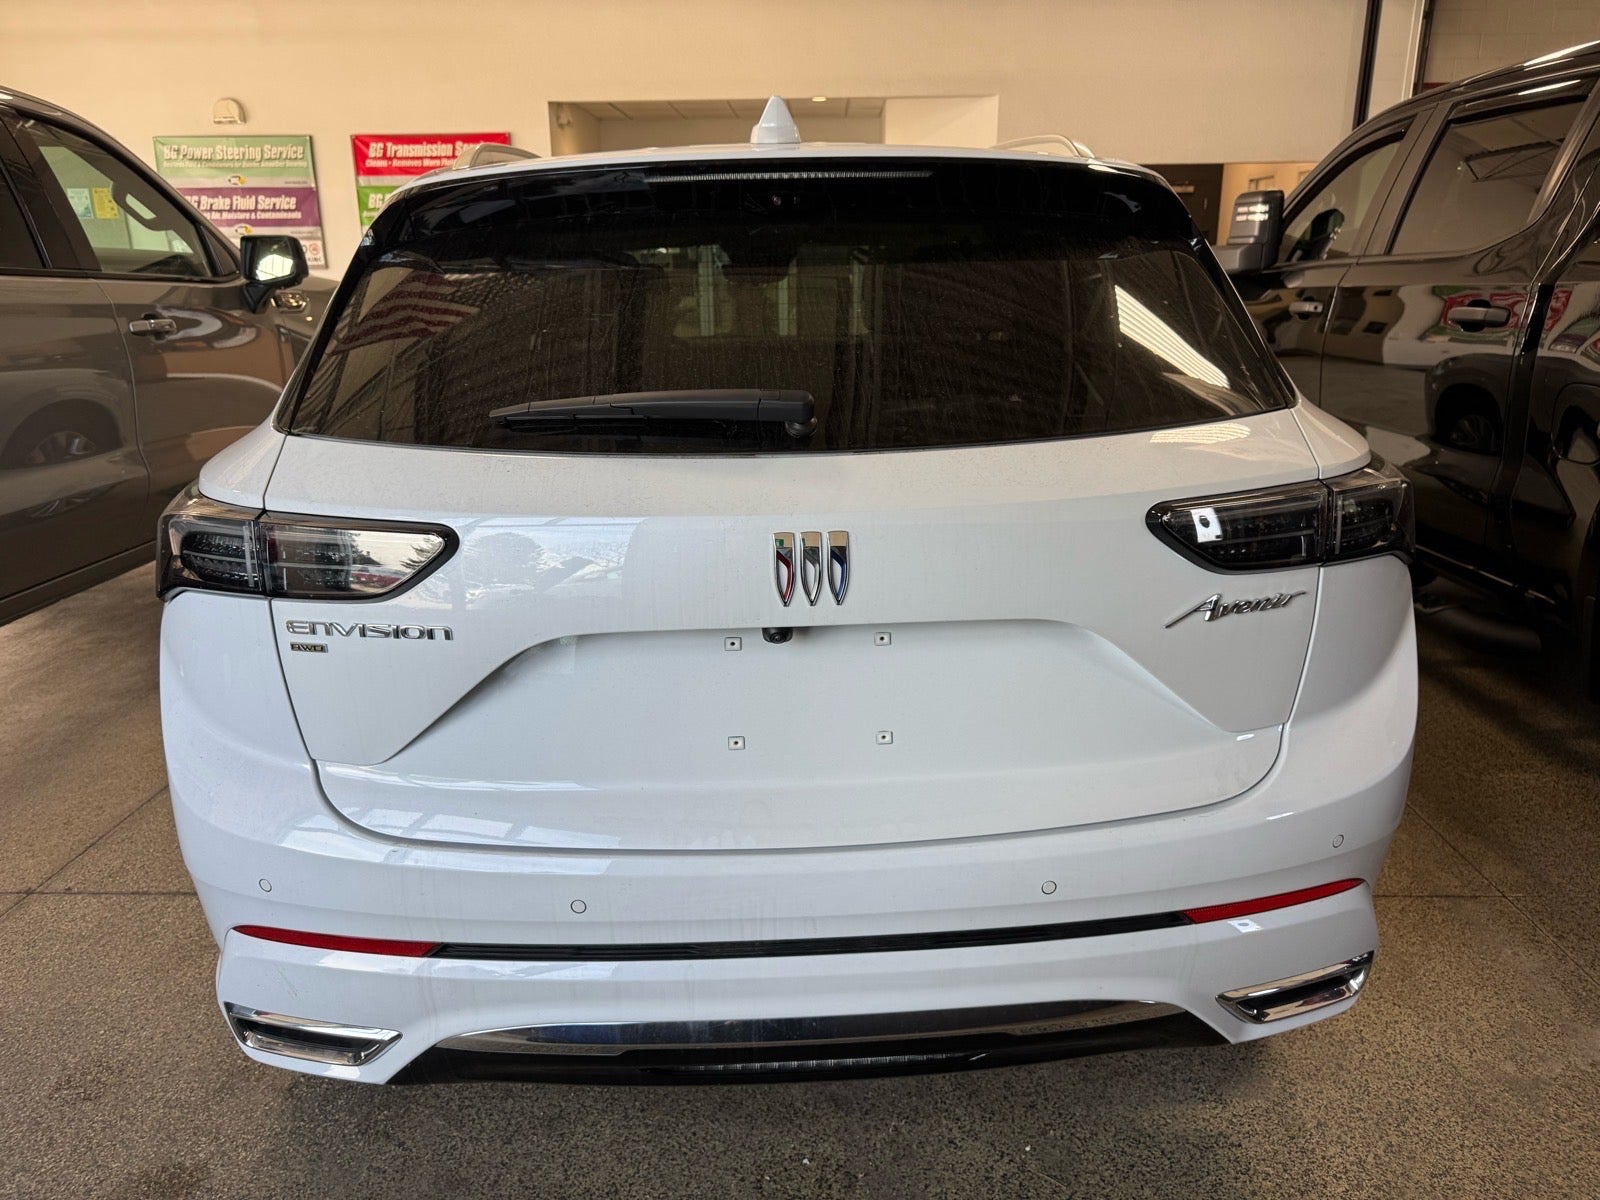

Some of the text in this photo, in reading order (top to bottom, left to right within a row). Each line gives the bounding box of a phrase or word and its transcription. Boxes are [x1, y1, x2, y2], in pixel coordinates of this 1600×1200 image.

[164, 144, 304, 162] BG Power Steering Service
[369, 142, 384, 158] BG
[386, 141, 453, 158] Transmission
[391, 158, 422, 168] Removes
[200, 195, 231, 210] Brake
[232, 195, 256, 210] Fluid
[257, 194, 297, 210] Service
[369, 192, 383, 209] BG
[256, 211, 302, 220] Contaminants
[1162, 590, 1307, 629] Avenir
[285, 619, 454, 641] ENVISION
